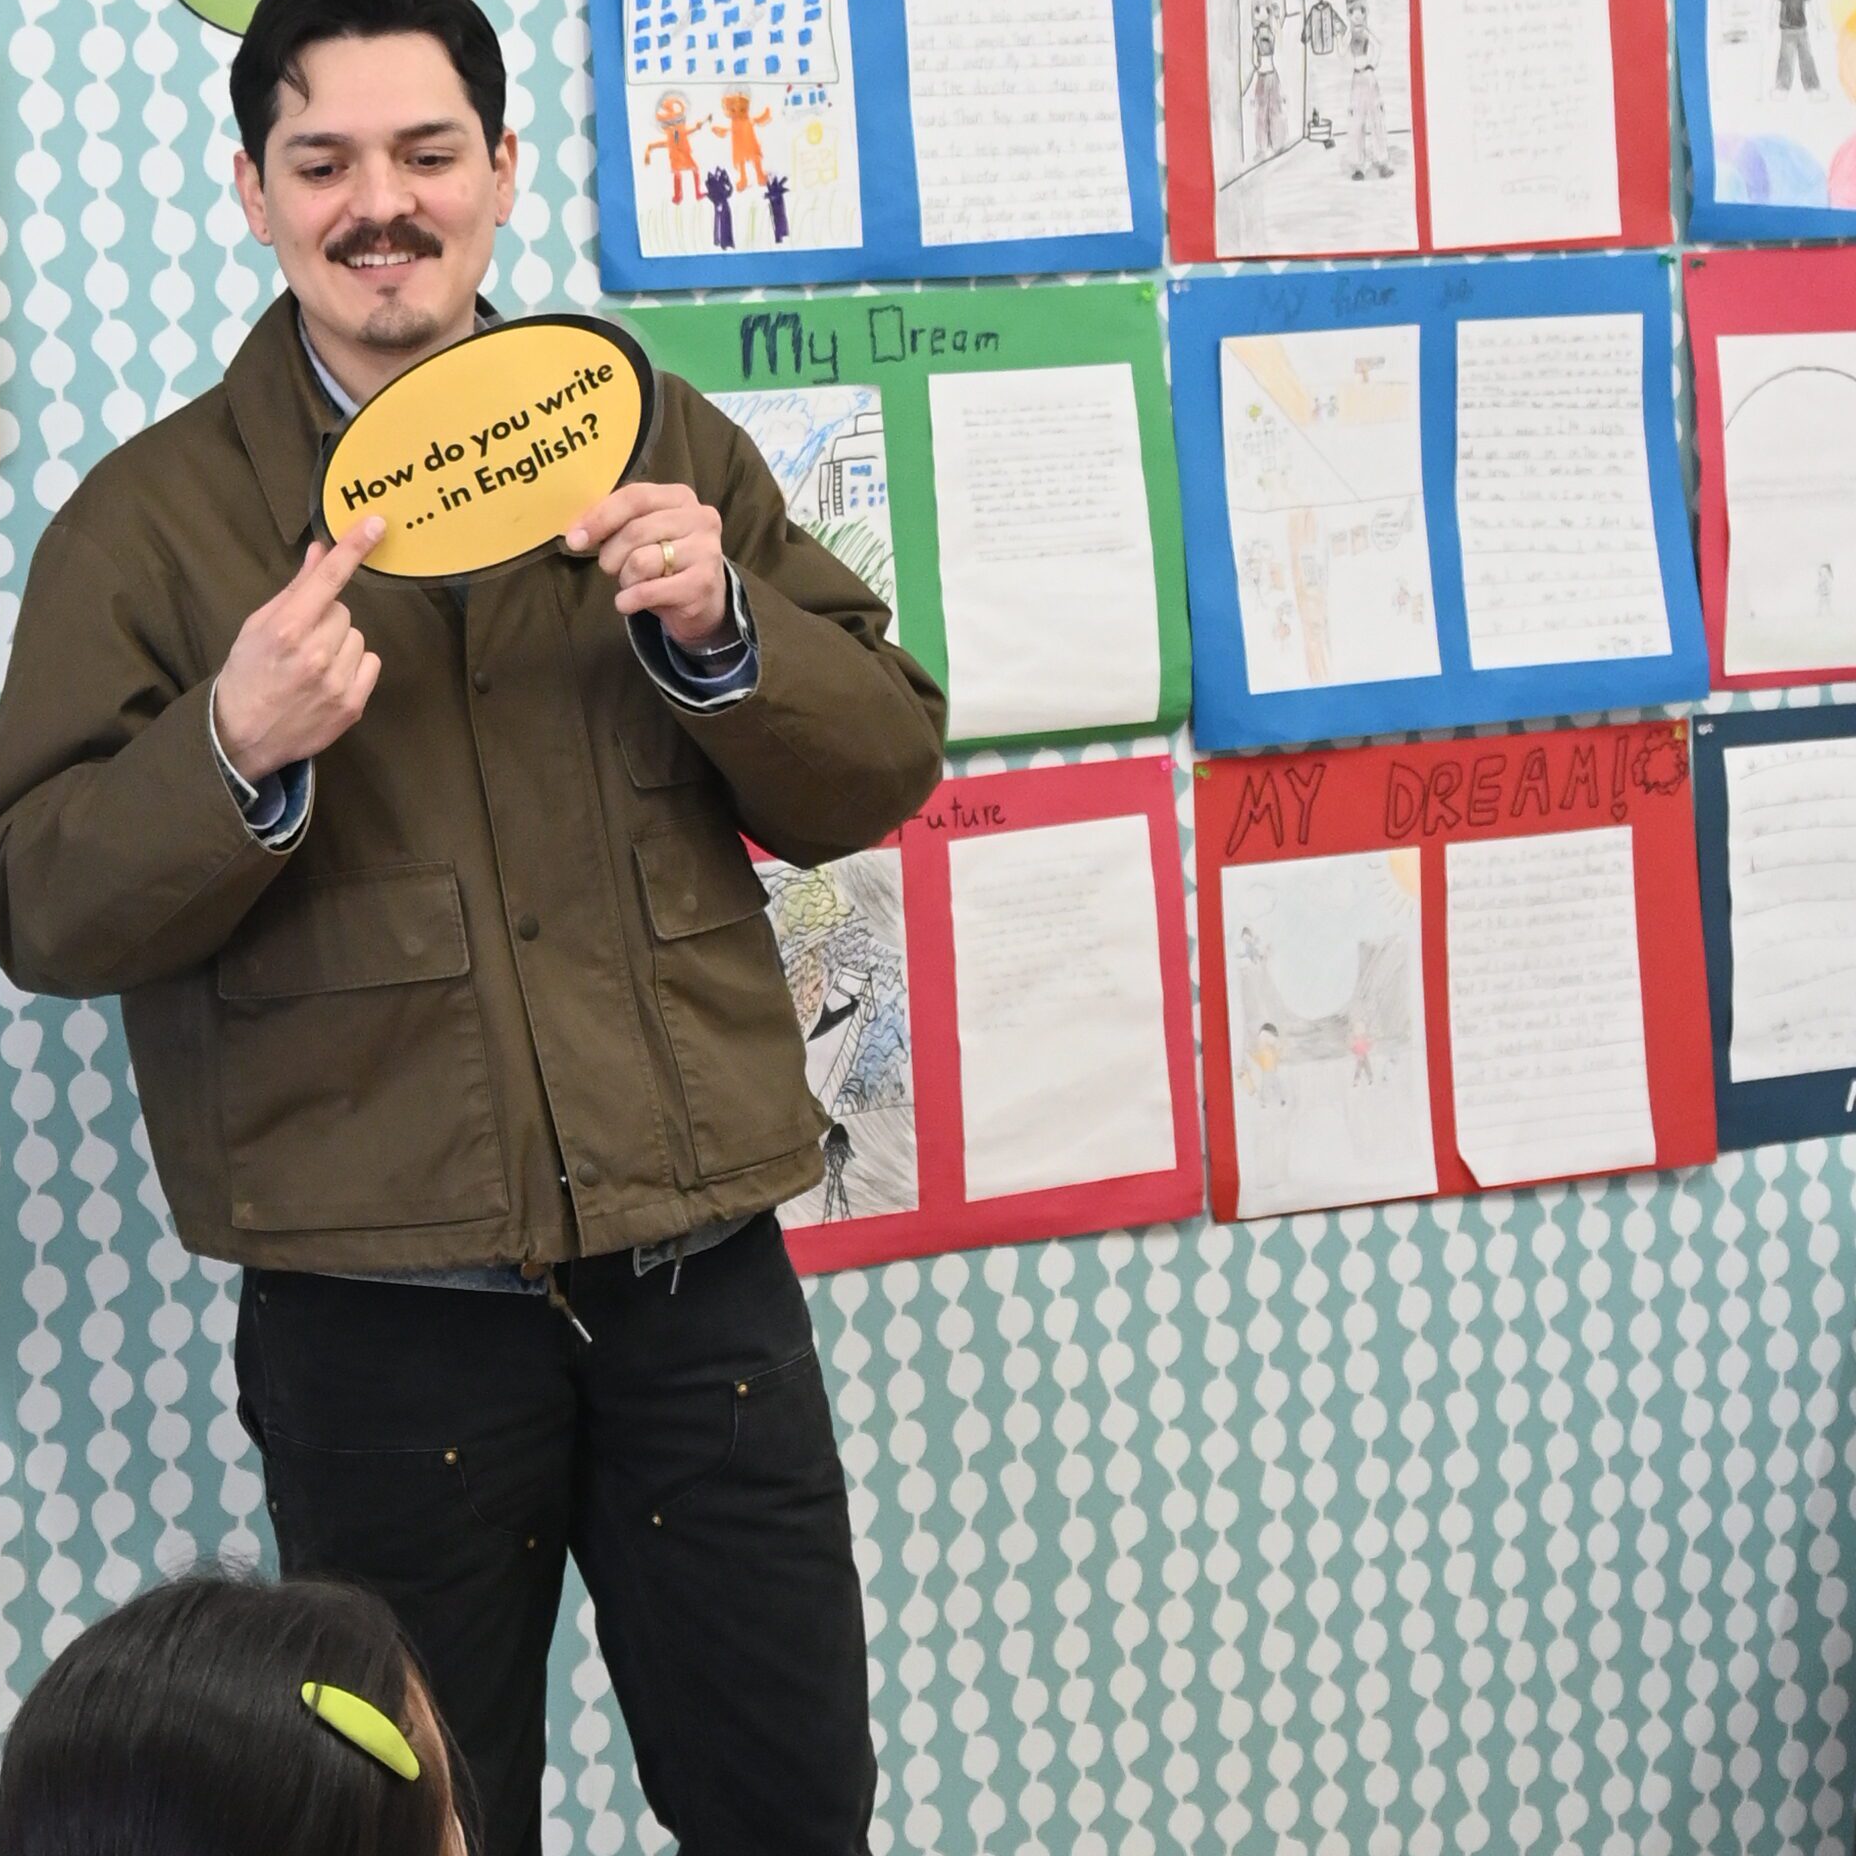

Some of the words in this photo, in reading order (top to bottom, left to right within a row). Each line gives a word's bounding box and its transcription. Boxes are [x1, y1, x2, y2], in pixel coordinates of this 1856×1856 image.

[740, 311, 839, 385] My
[867, 304, 1002, 364] Dream
[340, 463, 414, 512] How
[423, 441, 465, 472] do
[469, 409, 531, 458] you
[534, 364, 614, 416] write
[437, 486, 472, 512] in
[473, 412, 600, 496] English?
[1225, 762, 1326, 858] MY
